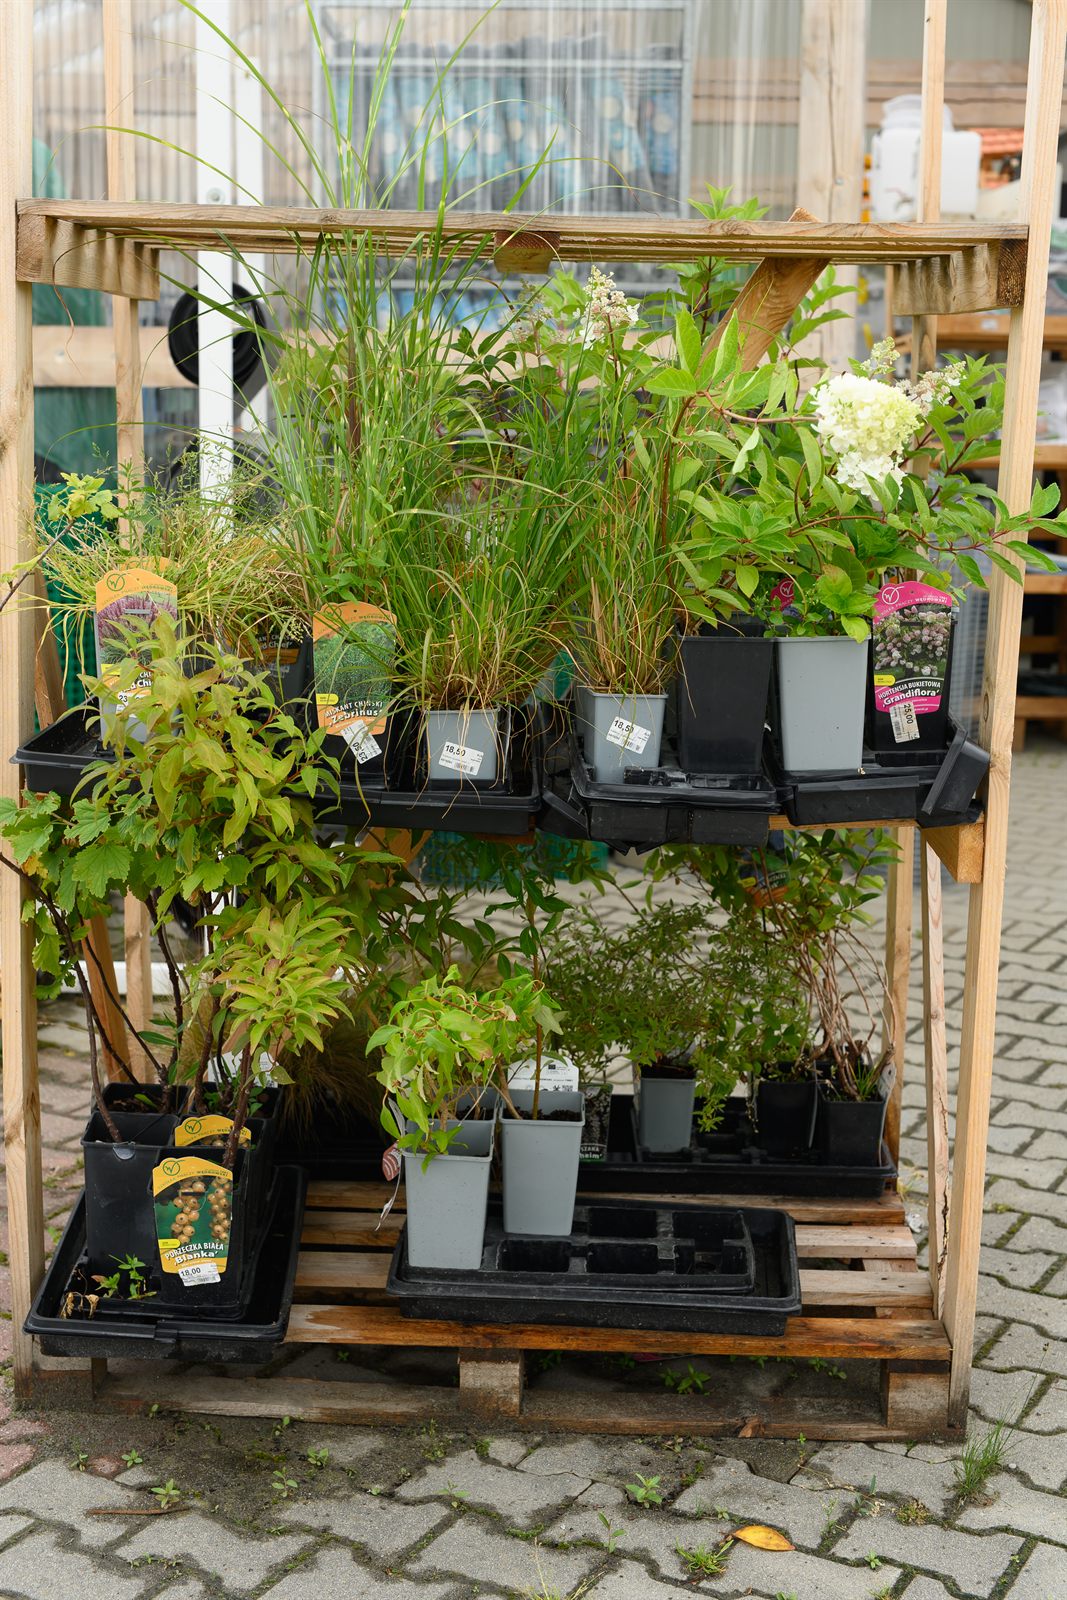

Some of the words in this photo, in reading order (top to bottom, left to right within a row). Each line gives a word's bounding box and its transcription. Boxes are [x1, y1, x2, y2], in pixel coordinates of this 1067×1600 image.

[908, 680, 941, 688] BUKIETOWA
[165, 1243, 203, 1261] PORZECZKA
[203, 1240, 224, 1250] BIAŁA
